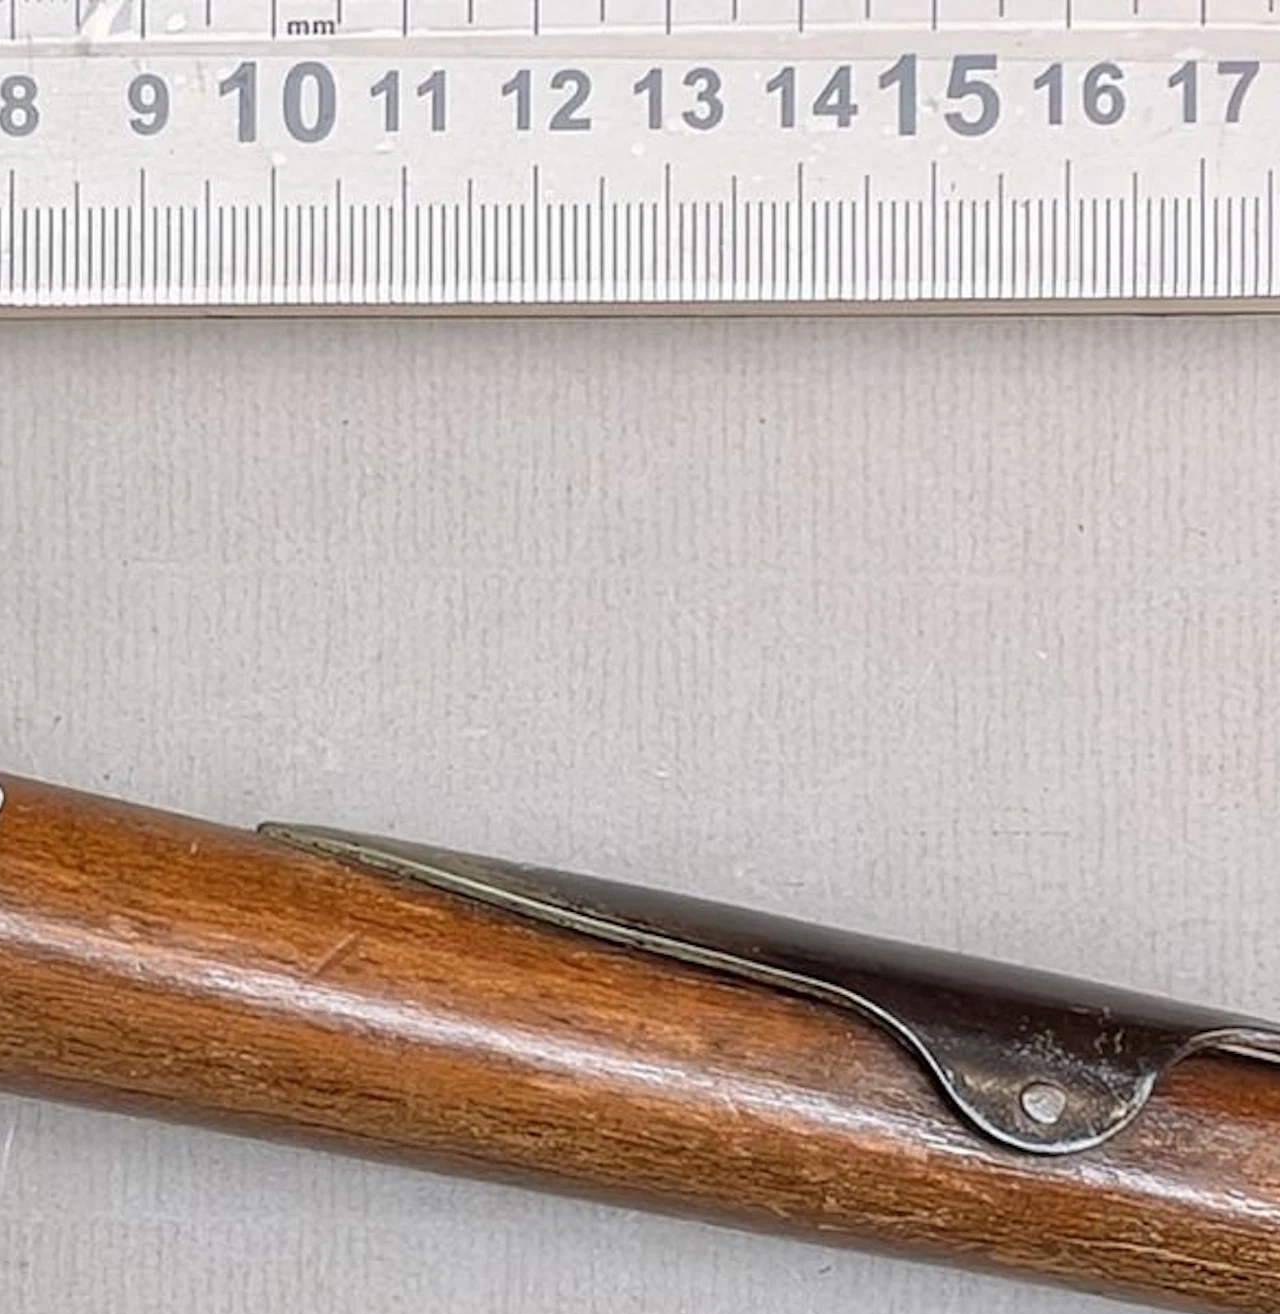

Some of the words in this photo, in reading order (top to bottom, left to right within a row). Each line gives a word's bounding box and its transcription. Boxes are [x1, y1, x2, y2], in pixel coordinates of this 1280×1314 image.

[287, 19, 335, 35] mm
[0, 76, 38, 135] 8
[128, 75, 168, 134] 9
[220, 62, 335, 142] 10
[371, 70, 445, 131] 11
[502, 70, 590, 130] 12
[634, 68, 723, 130] 13
[767, 66, 857, 127] 14
[879, 54, 999, 135] 15
[1034, 63, 1124, 124] 16
[1169, 60, 1259, 123] 17
